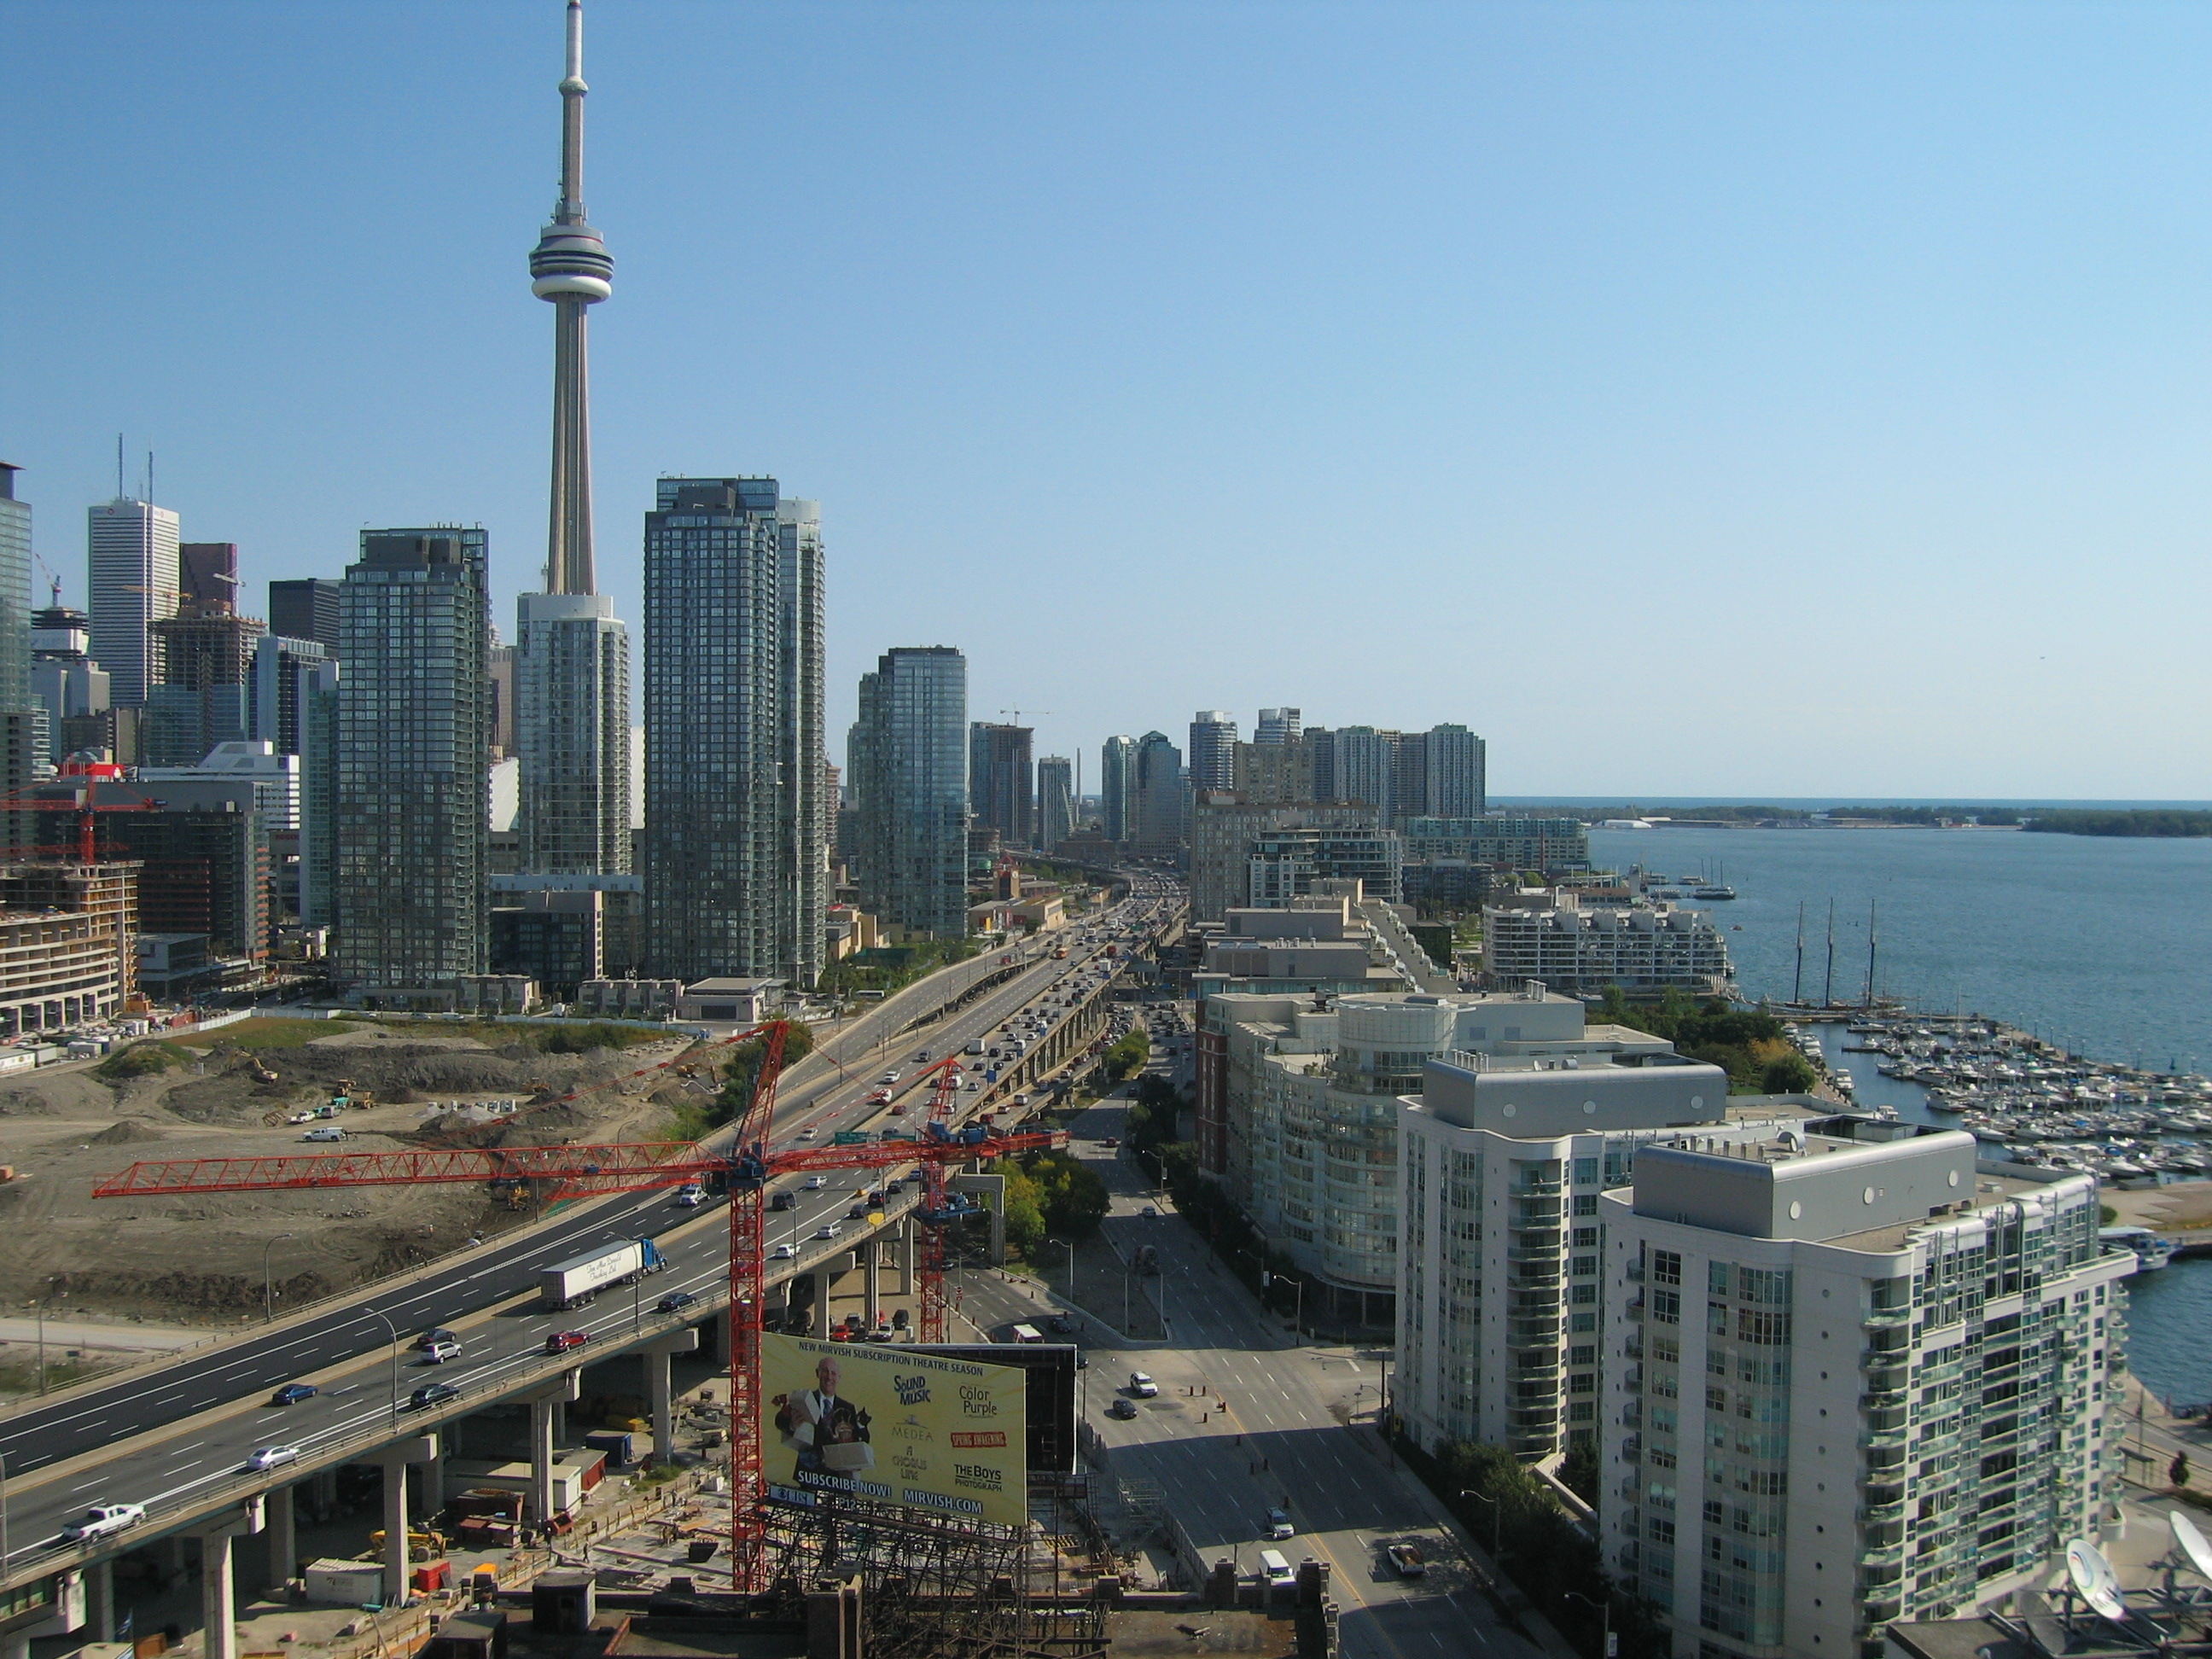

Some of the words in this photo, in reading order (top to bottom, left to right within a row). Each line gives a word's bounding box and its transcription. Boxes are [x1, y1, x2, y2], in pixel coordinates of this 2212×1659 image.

[799, 1341, 817, 1352] NEW
[818, 1344, 852, 1357] MIRVISH
[853, 1348, 911, 1365] SUBSCRIPTION
[913, 1357, 949, 1371] THEATRE
[951, 1364, 983, 1377] SEASON
[899, 1389, 931, 1406] MUSIC
[959, 1385, 989, 1400] Color
[963, 1400, 998, 1416] Purple
[892, 1427, 934, 1442] MEDEA
[906, 1446, 913, 1456] A
[892, 1455, 927, 1470] CHORUS
[954, 1464, 973, 1476] THE
[973, 1465, 1001, 1481] BOYS
[798, 1470, 856, 1492] SUBSCRIBE
[859, 1481, 892, 1498] NOW!
[955, 1478, 1002, 1492] PHOTOGRAPH
[904, 1489, 982, 1514] MIRVISH.COM
